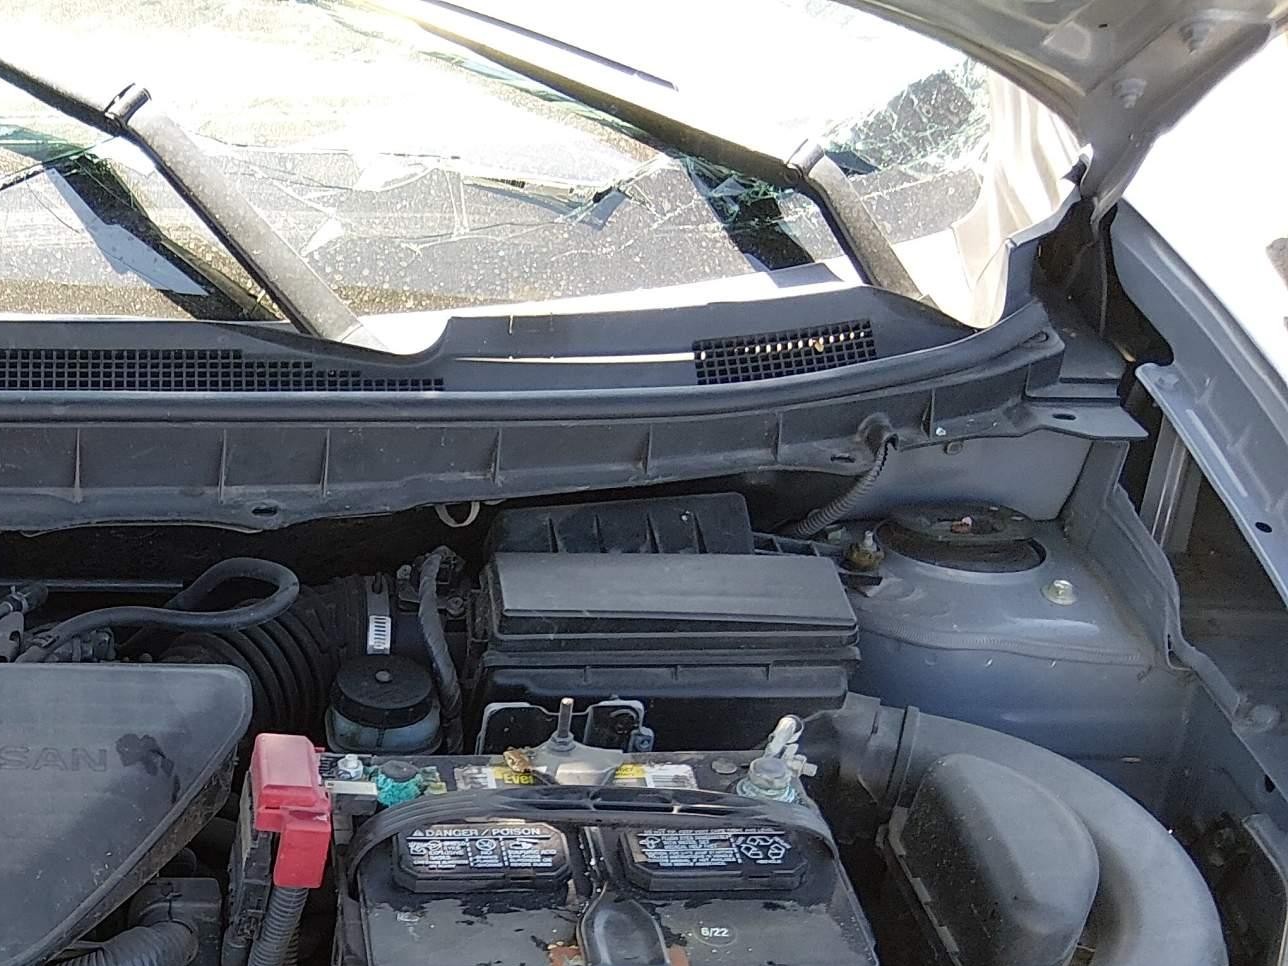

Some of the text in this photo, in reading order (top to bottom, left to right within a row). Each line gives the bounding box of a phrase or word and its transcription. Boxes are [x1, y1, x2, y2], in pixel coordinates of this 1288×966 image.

[425, 828, 541, 837] DANGER / POISON
